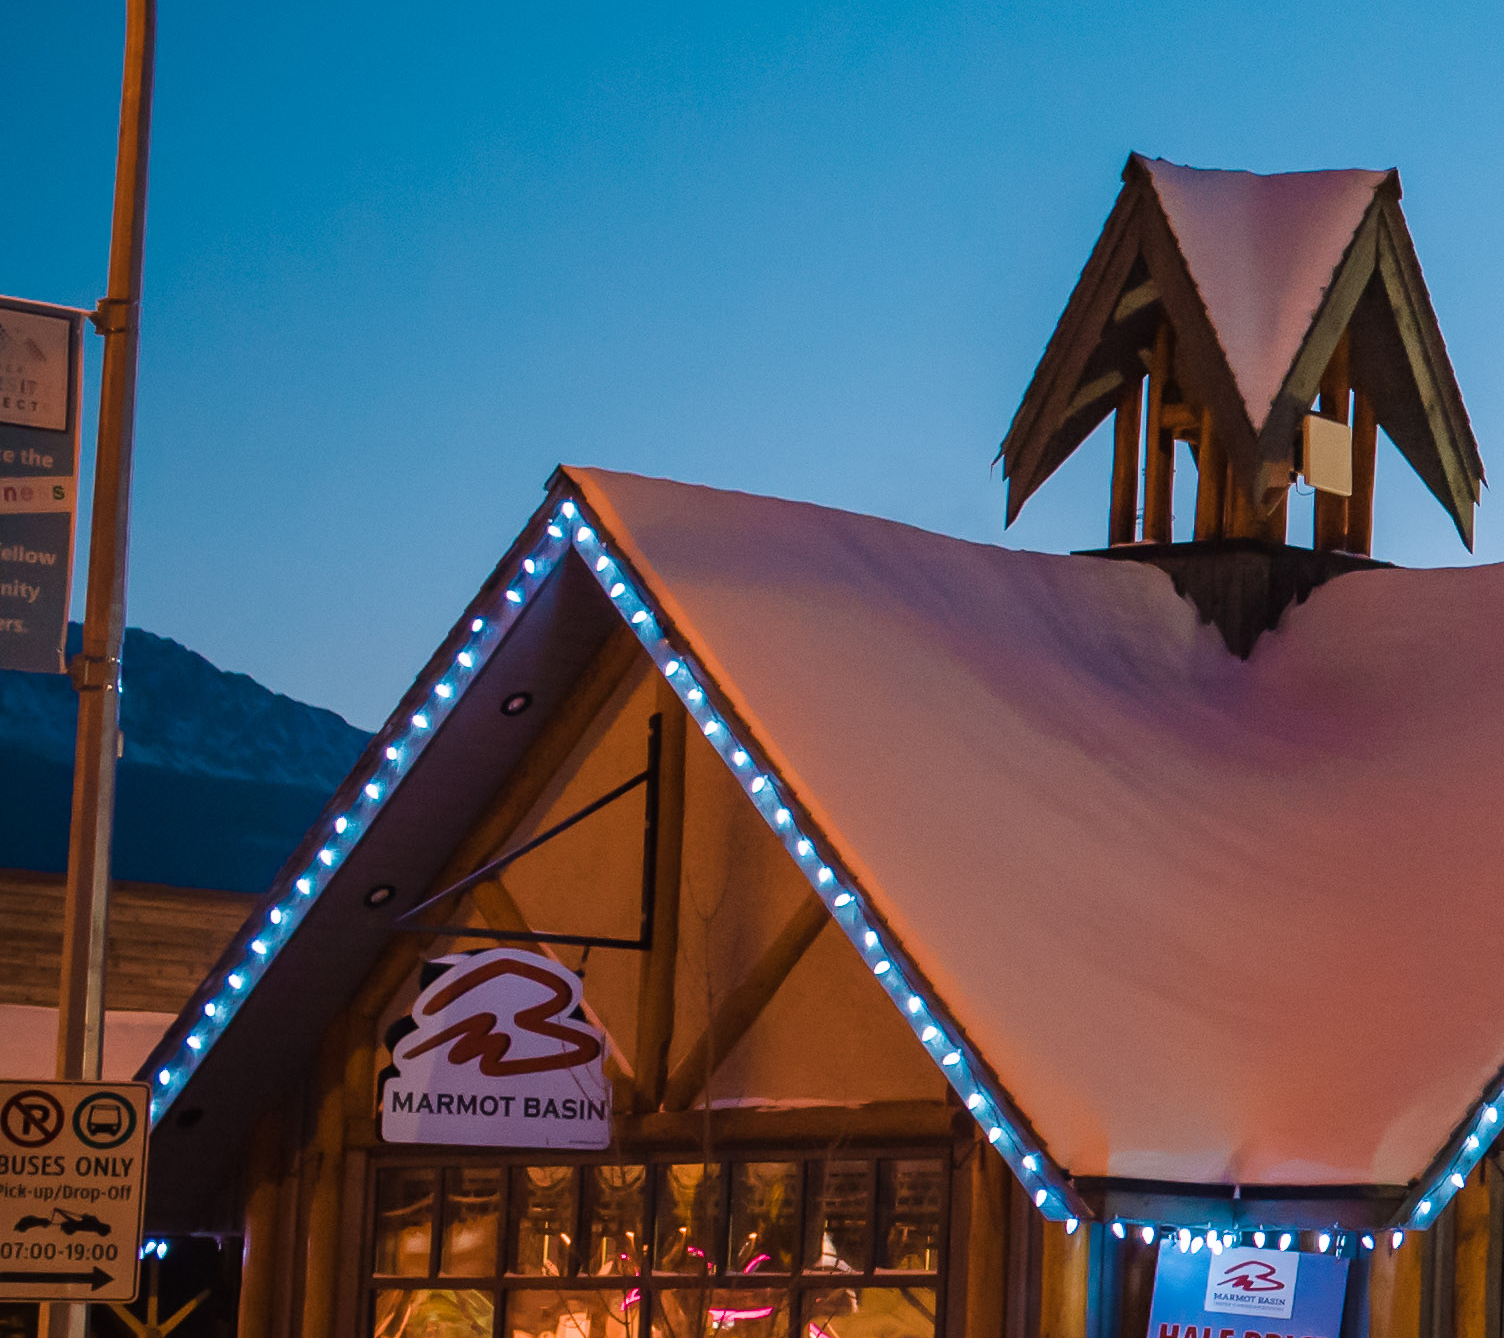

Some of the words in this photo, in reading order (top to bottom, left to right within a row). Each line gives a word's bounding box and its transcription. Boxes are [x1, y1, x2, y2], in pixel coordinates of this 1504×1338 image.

[20, 447, 54, 469] the
[0, 543, 56, 566] ellow
[391, 1091, 516, 1117] MARMOT
[523, 1096, 606, 1121] BASIN
[75, 1156, 134, 1178] ONLY
[0, 1241, 119, 1262] 07:00-19:00
[1213, 1292, 1256, 1304] MARMOT
[1257, 1296, 1287, 1307] BASIN
